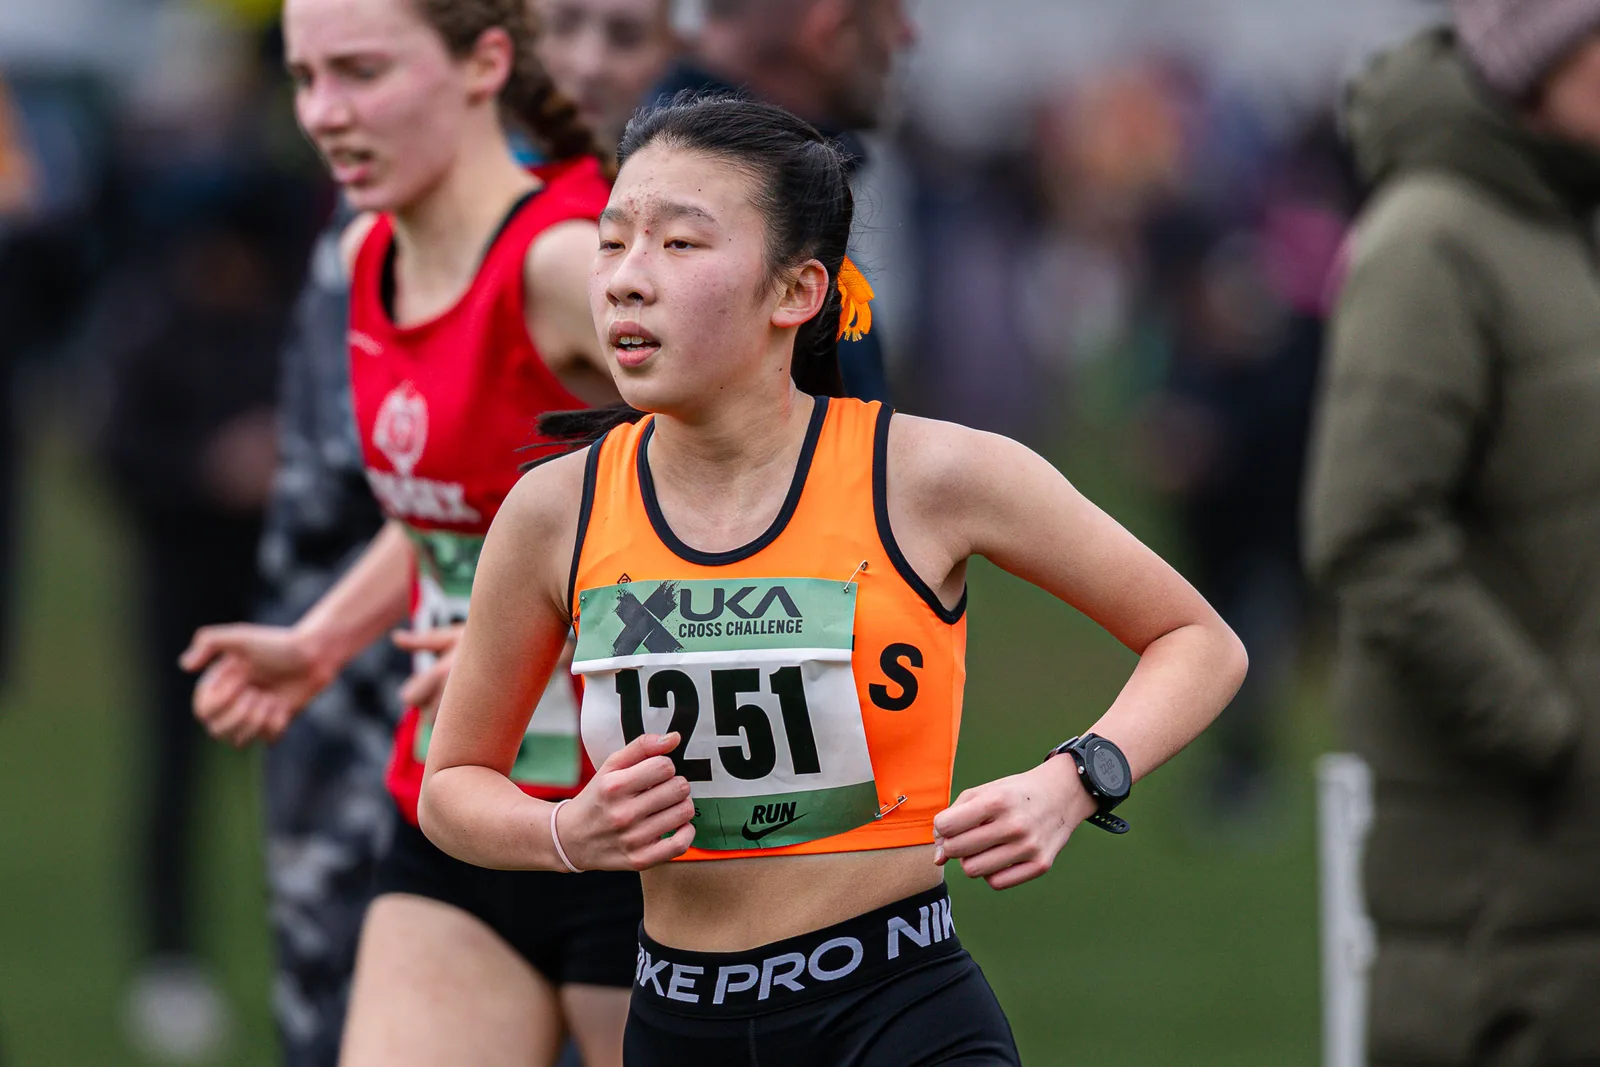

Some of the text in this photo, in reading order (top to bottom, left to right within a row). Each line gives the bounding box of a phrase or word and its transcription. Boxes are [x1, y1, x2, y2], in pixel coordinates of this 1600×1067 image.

[678, 619, 803, 638] CROSS CHALLENGE
[679, 586, 803, 622] UKA
[869, 642, 923, 712] S
[615, 666, 822, 782] 1251
[750, 801, 797, 825] RUN
[636, 895, 956, 1005] IKE PRO NIK
